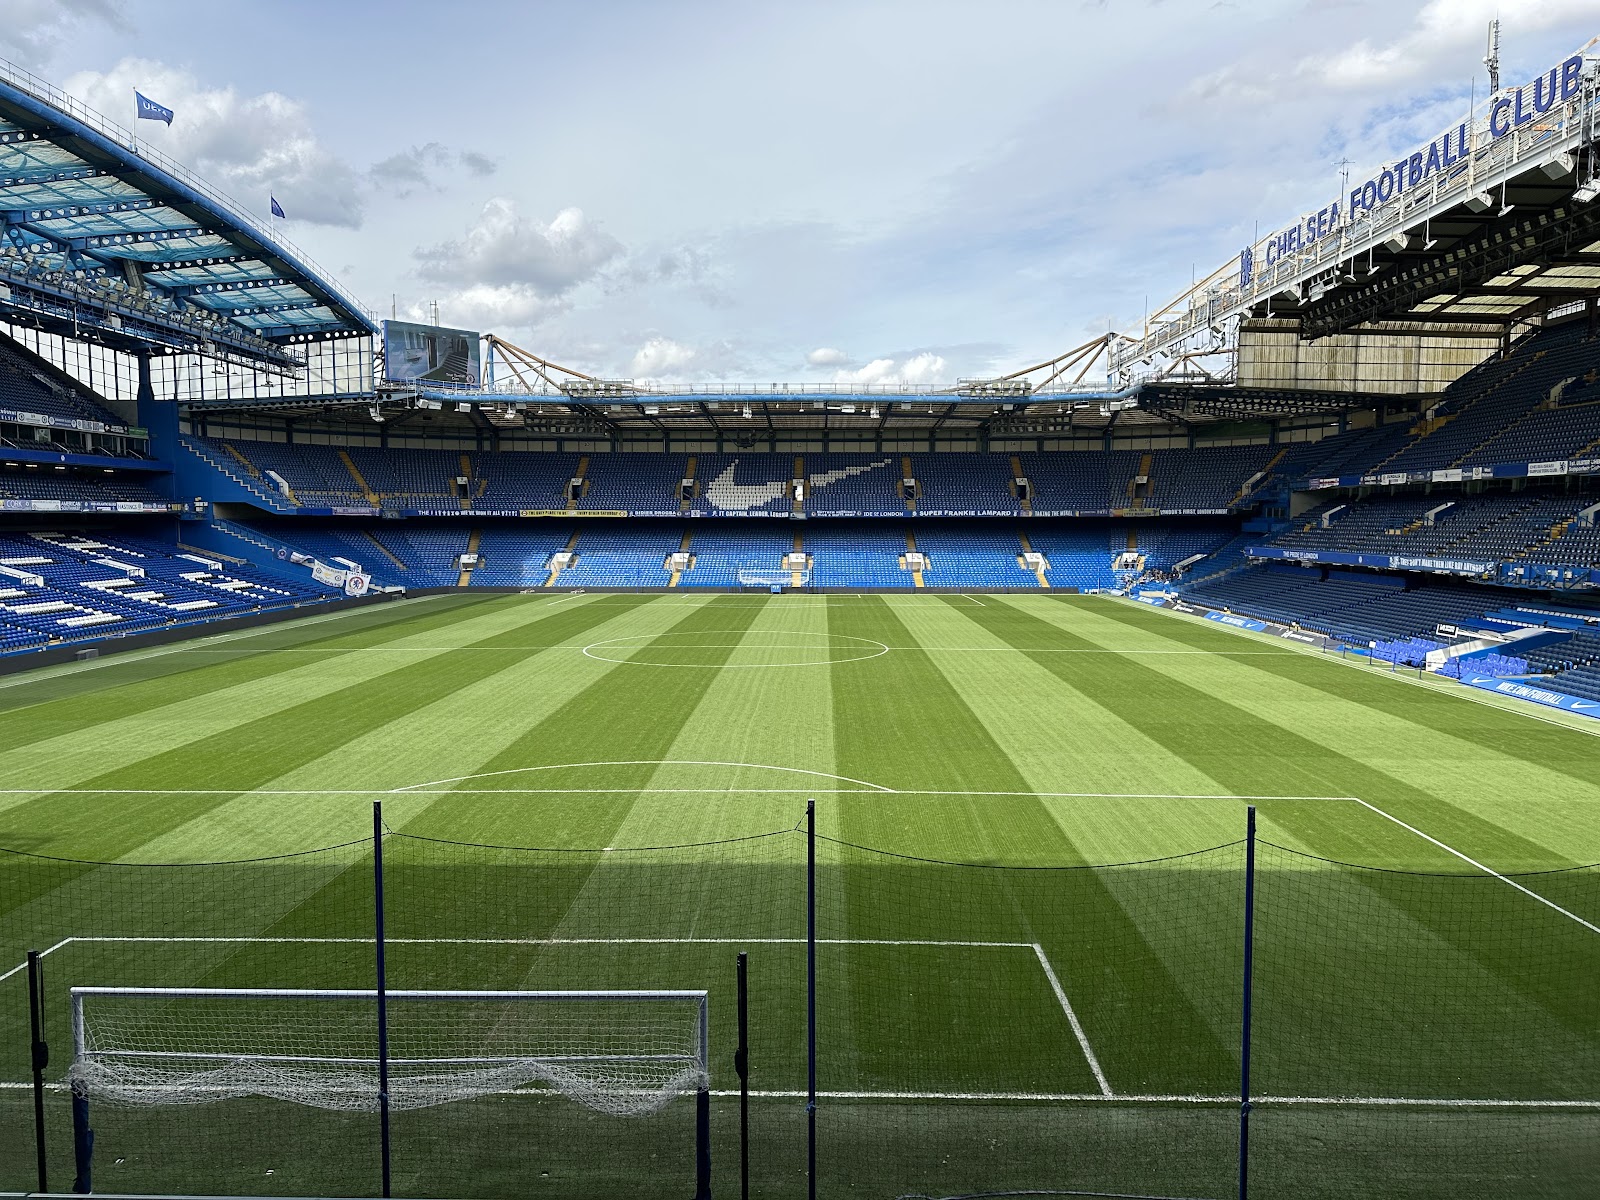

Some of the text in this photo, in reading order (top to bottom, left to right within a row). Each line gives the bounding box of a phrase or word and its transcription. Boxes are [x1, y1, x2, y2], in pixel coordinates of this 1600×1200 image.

[1266, 55, 1583, 266] CHELSEA FOOTBALL CLUB
